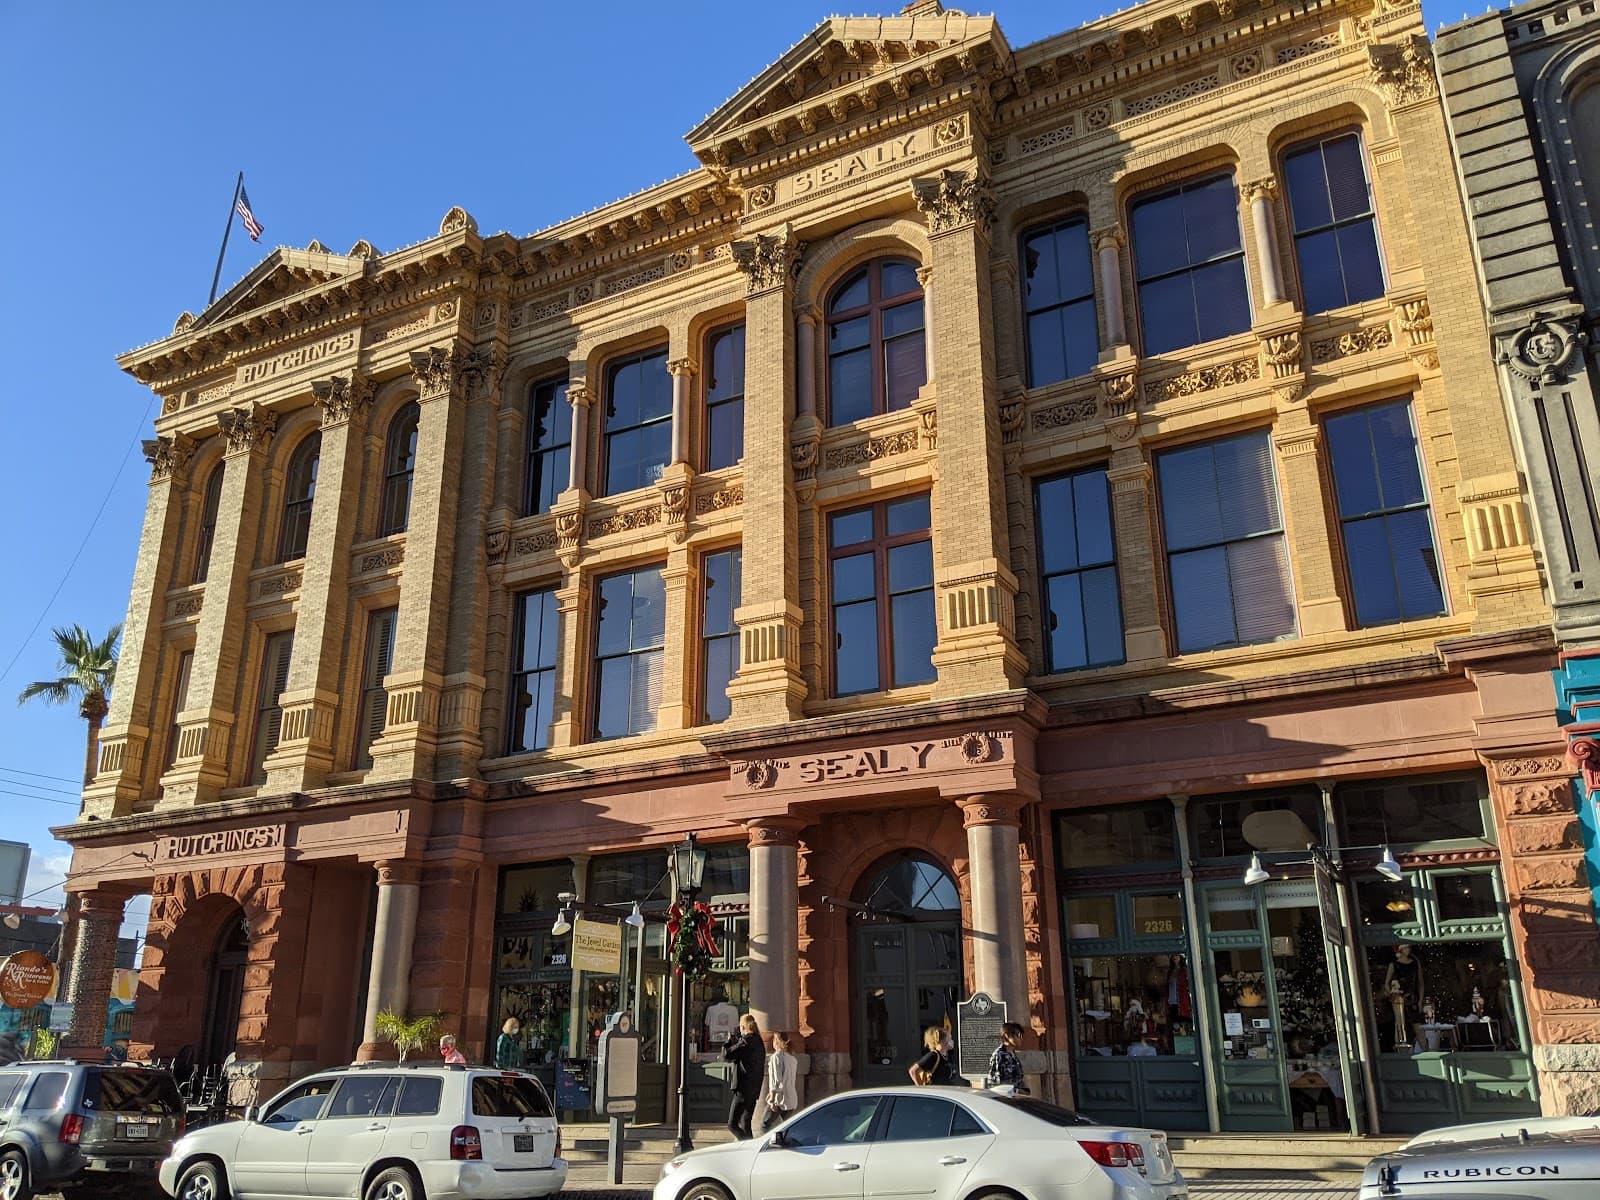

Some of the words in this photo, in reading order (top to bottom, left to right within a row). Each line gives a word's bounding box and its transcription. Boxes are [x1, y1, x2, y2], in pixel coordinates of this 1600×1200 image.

[795, 135, 916, 195] SEALY
[243, 333, 355, 384] HUTCHINGS
[800, 743, 935, 783] SEALY
[168, 827, 273, 859] HUTCHINGS
[575, 934, 586, 945] The
[1144, 919, 1173, 934] 2326
[1423, 1165, 1560, 1179] RUBICON
